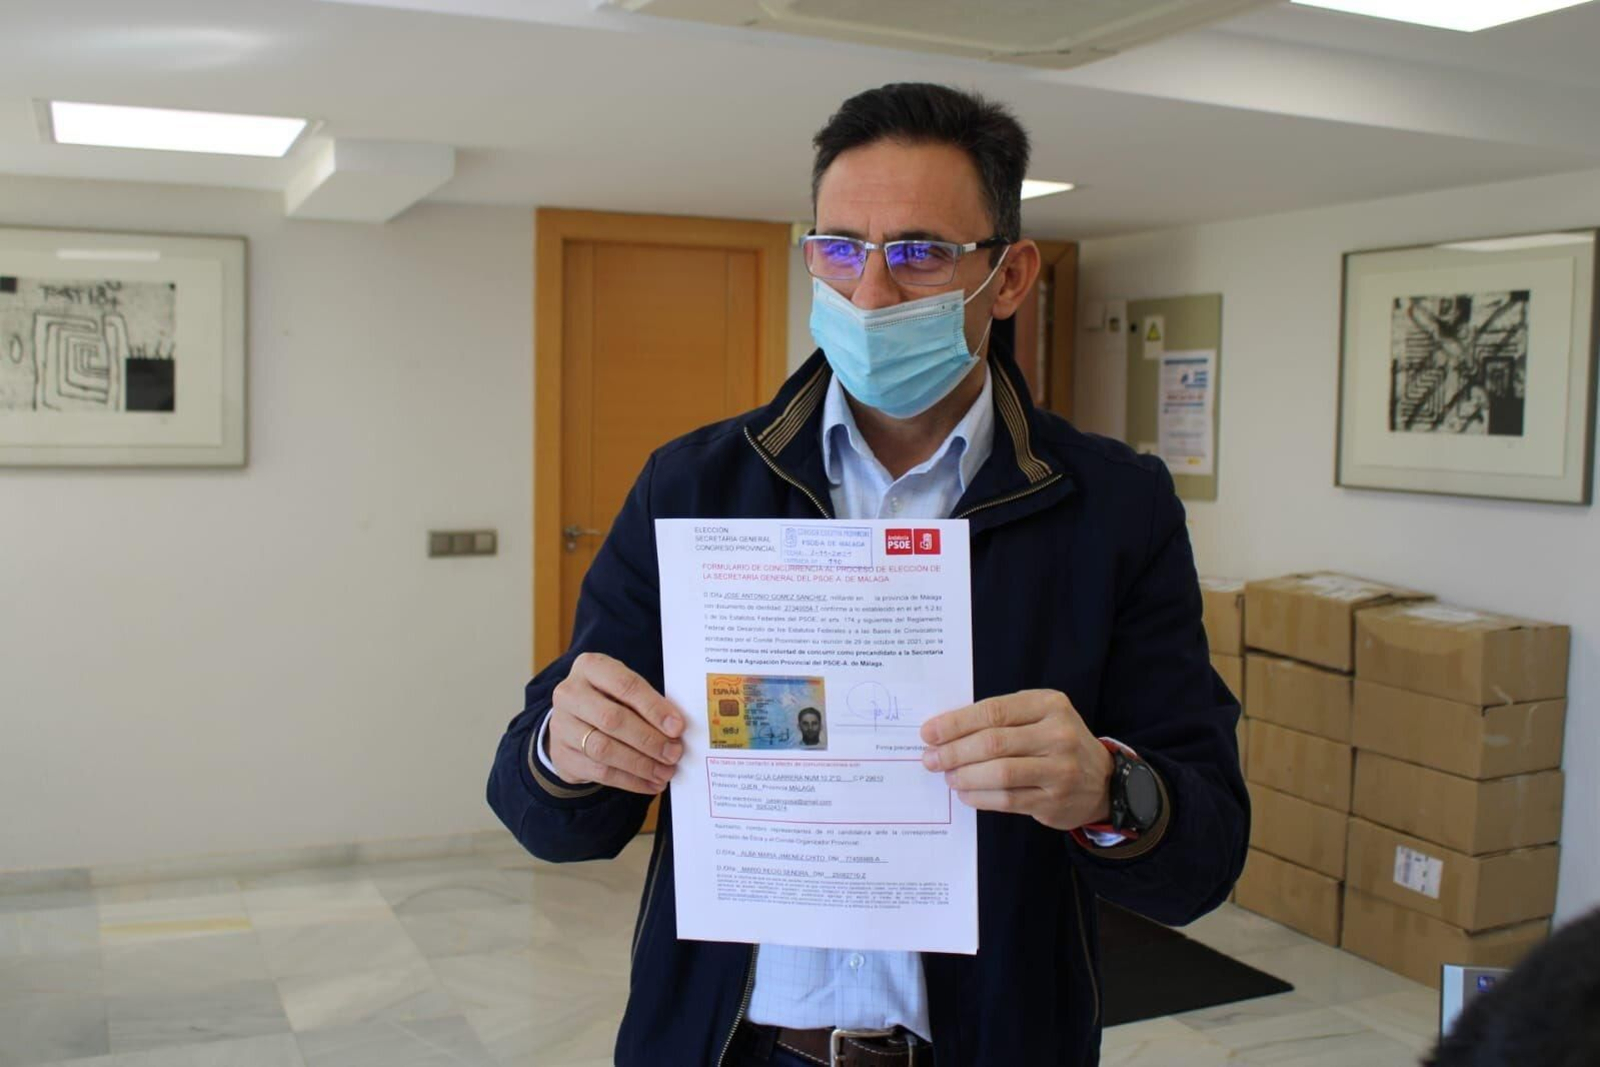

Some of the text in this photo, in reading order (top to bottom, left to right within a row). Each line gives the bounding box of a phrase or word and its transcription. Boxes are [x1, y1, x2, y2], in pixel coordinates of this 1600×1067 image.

[694, 544, 776, 552] CONGRESO PROVINCIAL
[887, 540, 911, 550] PSOE
[702, 563, 941, 574] FORMULARIO DE CONCURRENCIA AL PROCESO DE ELECCIÓN DE
[760, 574, 796, 582] GENERAL
[797, 574, 811, 582] DEL
[845, 575, 856, 583] DE
[861, 605, 896, 613] establecido
[906, 615, 943, 624] Reglamento
[903, 625, 943, 635] Convocatoria
[769, 648, 797, 656] voluntad
[836, 649, 855, 657] como
[855, 649, 897, 658] precandidato
[704, 656, 728, 664] General
[780, 658, 812, 666] Provincial
[850, 659, 859, 667] de
[713, 686, 740, 696] ESPAÑA
[900, 828, 949, 838] correspondiente
